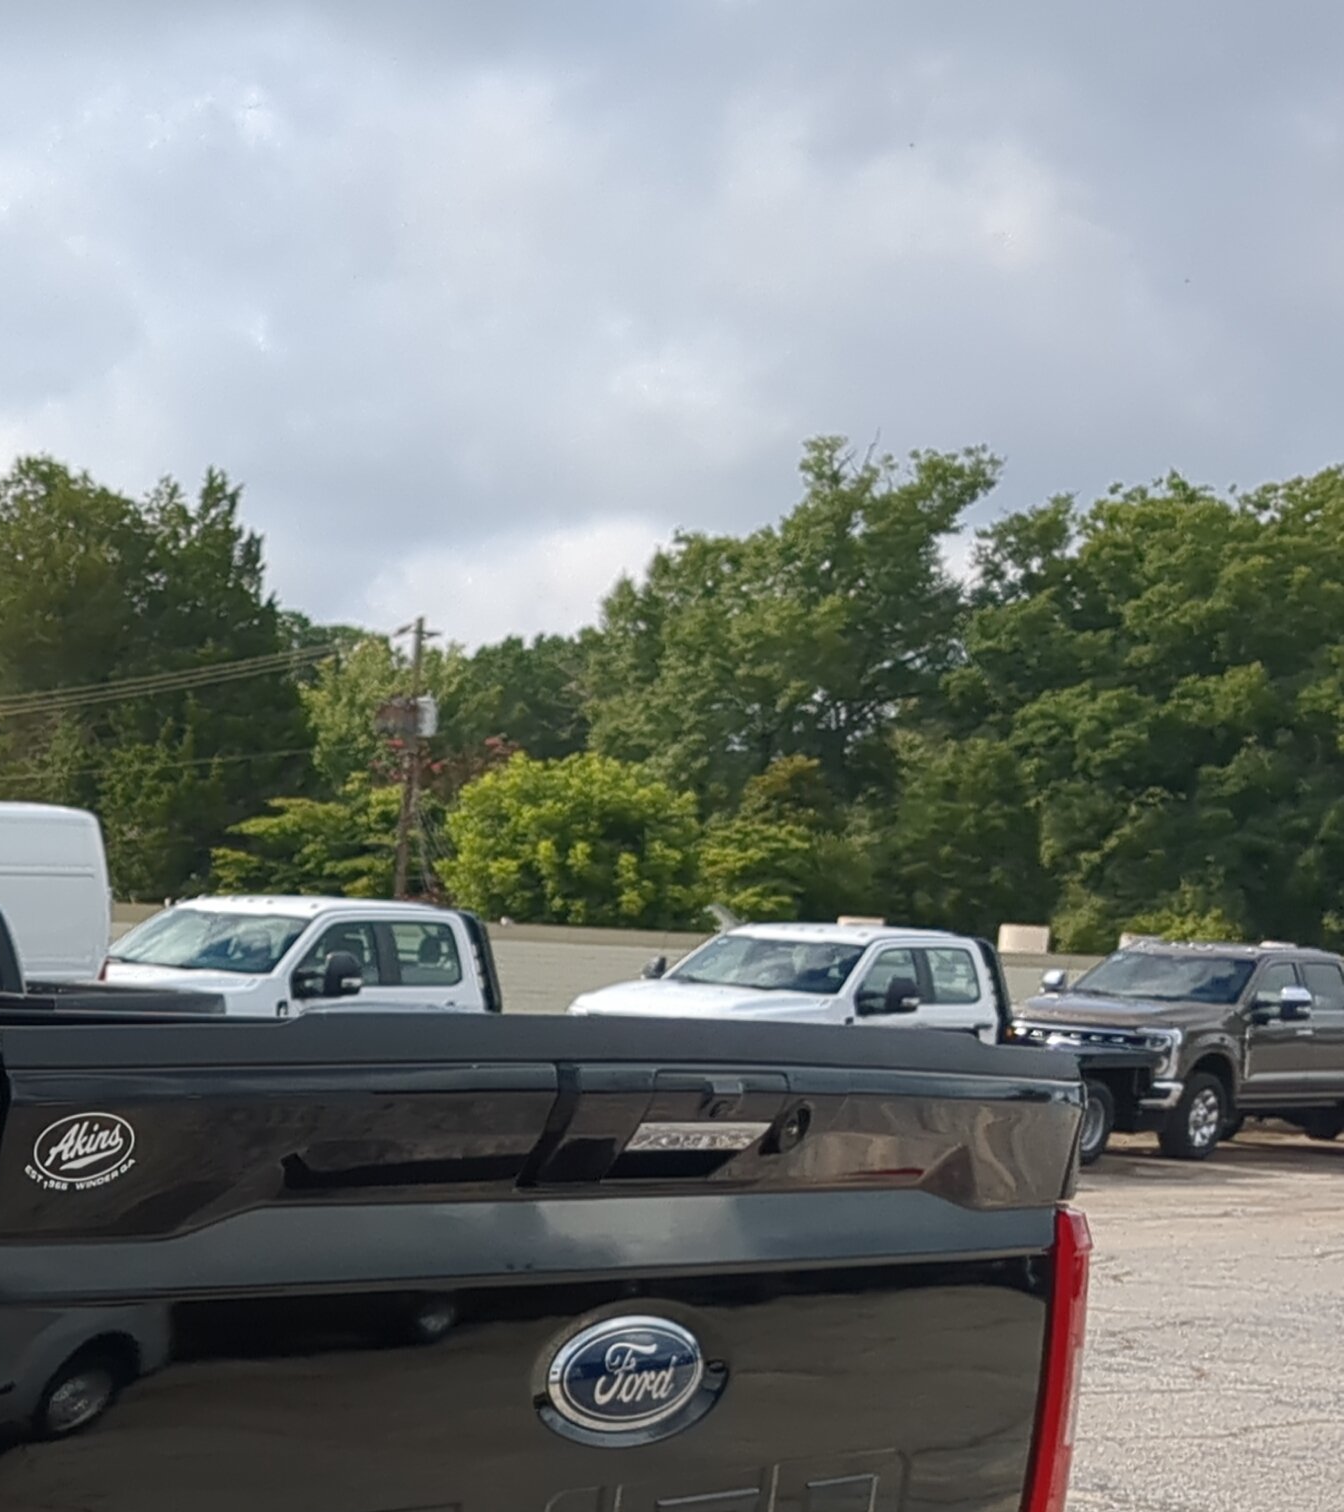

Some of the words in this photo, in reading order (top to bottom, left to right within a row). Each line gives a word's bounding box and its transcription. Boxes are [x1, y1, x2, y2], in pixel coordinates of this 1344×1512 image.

[44, 1120, 124, 1169] Akins
[24, 1164, 43, 1183] EST
[75, 1171, 119, 1190] WINDER
[120, 1158, 136, 1174] GA
[594, 1342, 677, 1405] Ford
